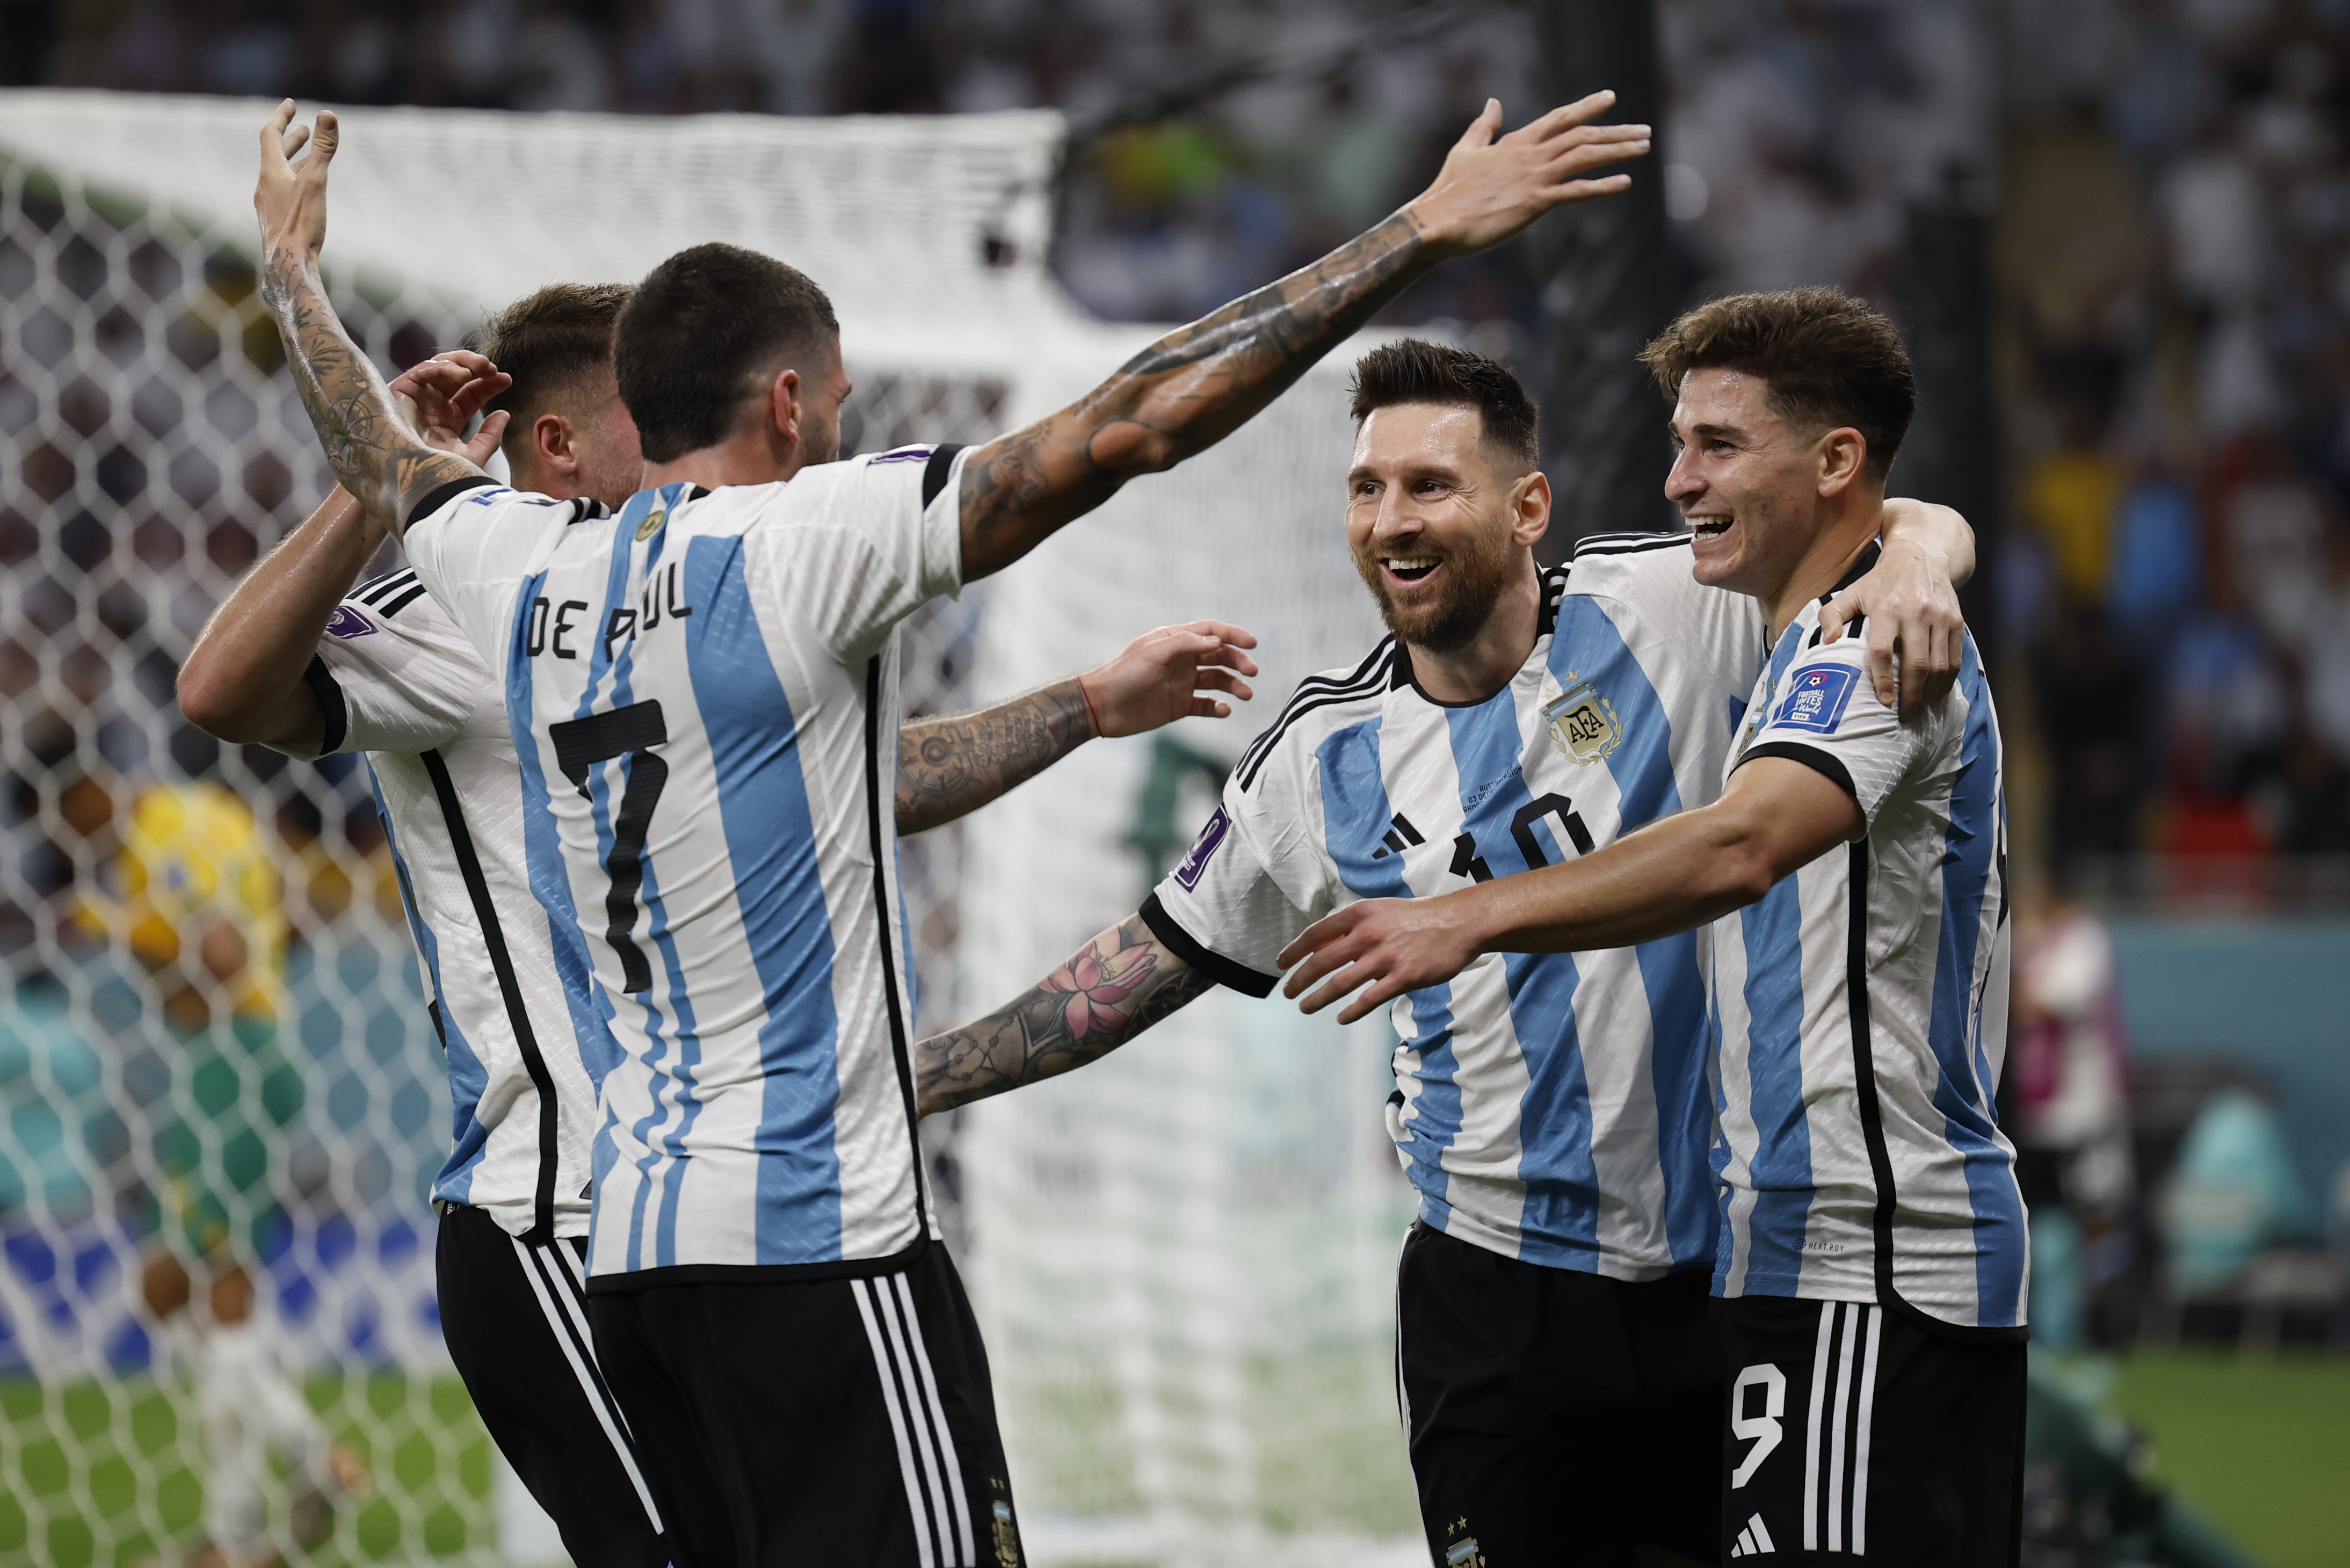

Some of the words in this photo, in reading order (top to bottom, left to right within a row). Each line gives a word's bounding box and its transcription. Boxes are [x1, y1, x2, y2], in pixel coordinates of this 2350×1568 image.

[526, 597, 589, 659] DE
[1798, 689, 1824, 698] FOOTBALL
[1798, 704, 1822, 715] World
[1564, 705, 1605, 744] AFA
[1478, 789, 1495, 800] DECE
[549, 699, 668, 994] 7
[1809, 1242, 1844, 1252] HEAT.RDY
[1731, 1363, 1787, 1490] 9
